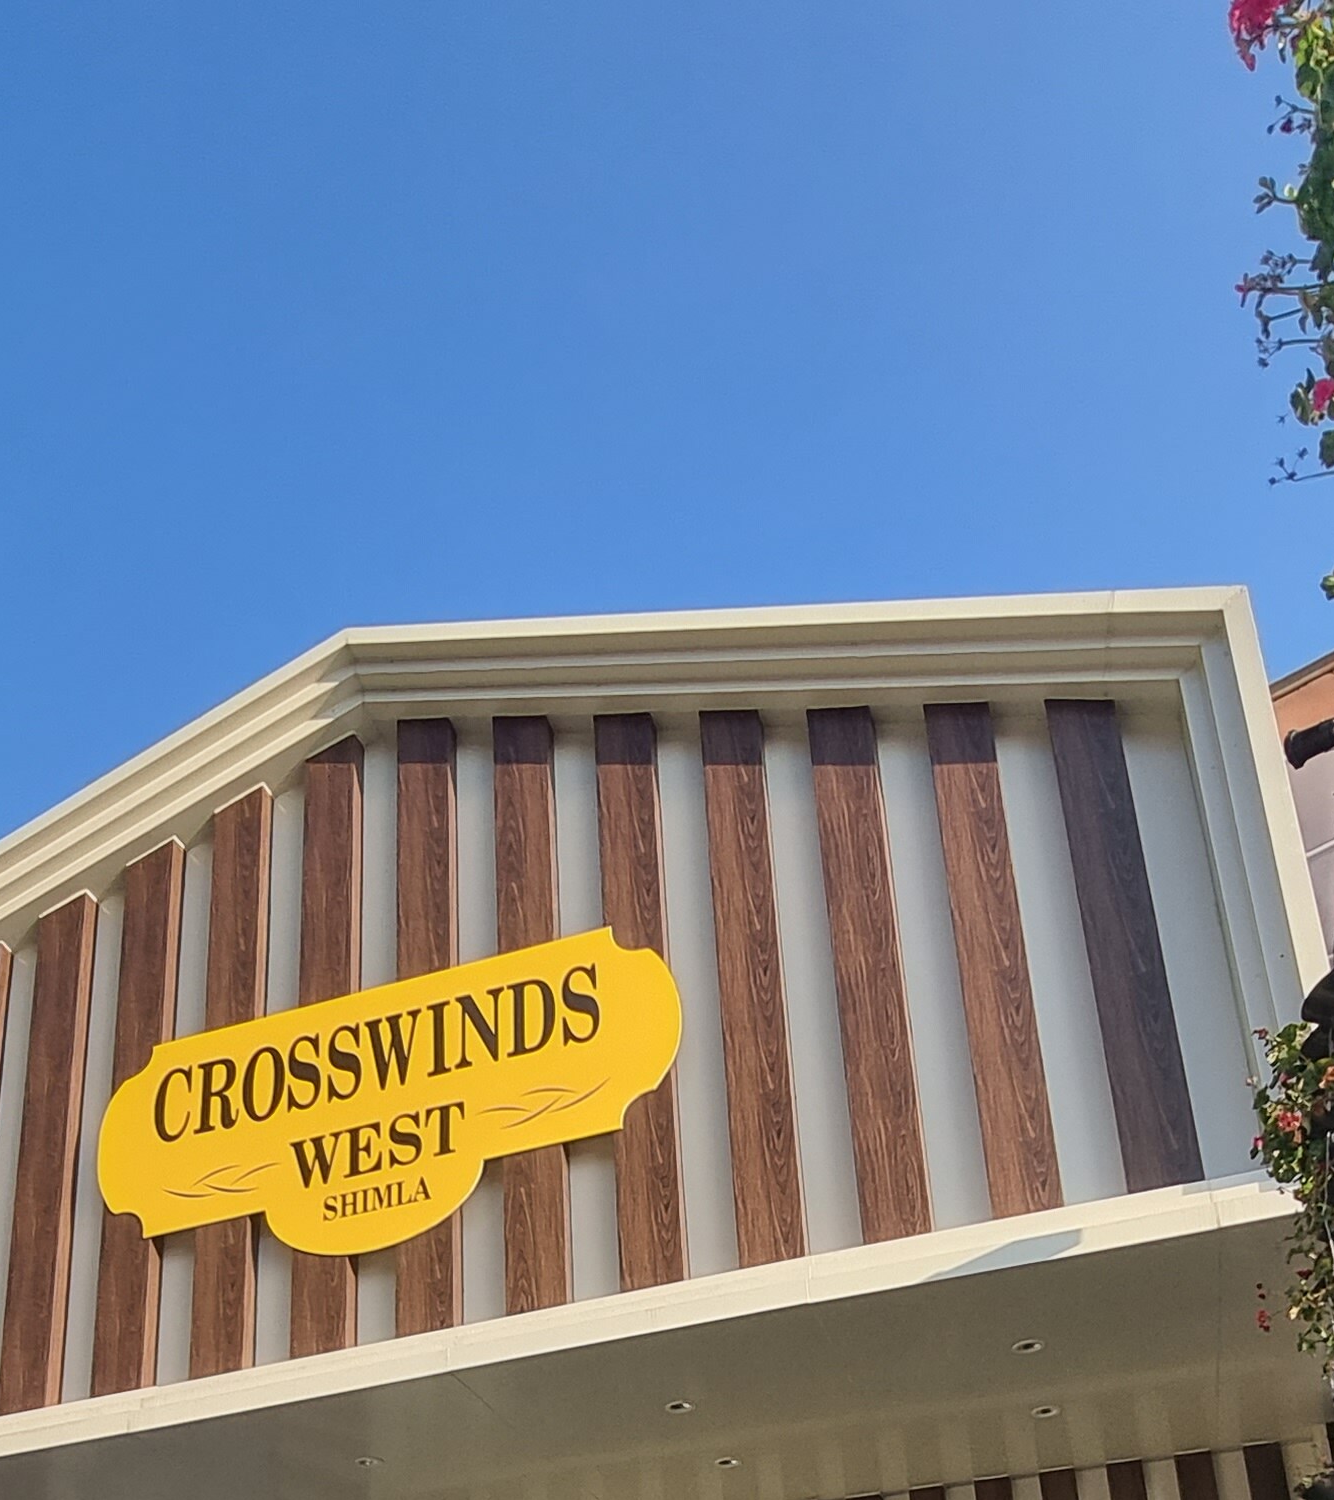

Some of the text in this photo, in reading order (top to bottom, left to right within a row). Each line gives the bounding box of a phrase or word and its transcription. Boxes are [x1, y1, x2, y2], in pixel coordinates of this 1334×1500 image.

[154, 963, 601, 1143] CROSSWINDS
[289, 1101, 465, 1189] WEST
[323, 1177, 432, 1222] SHIMLA
